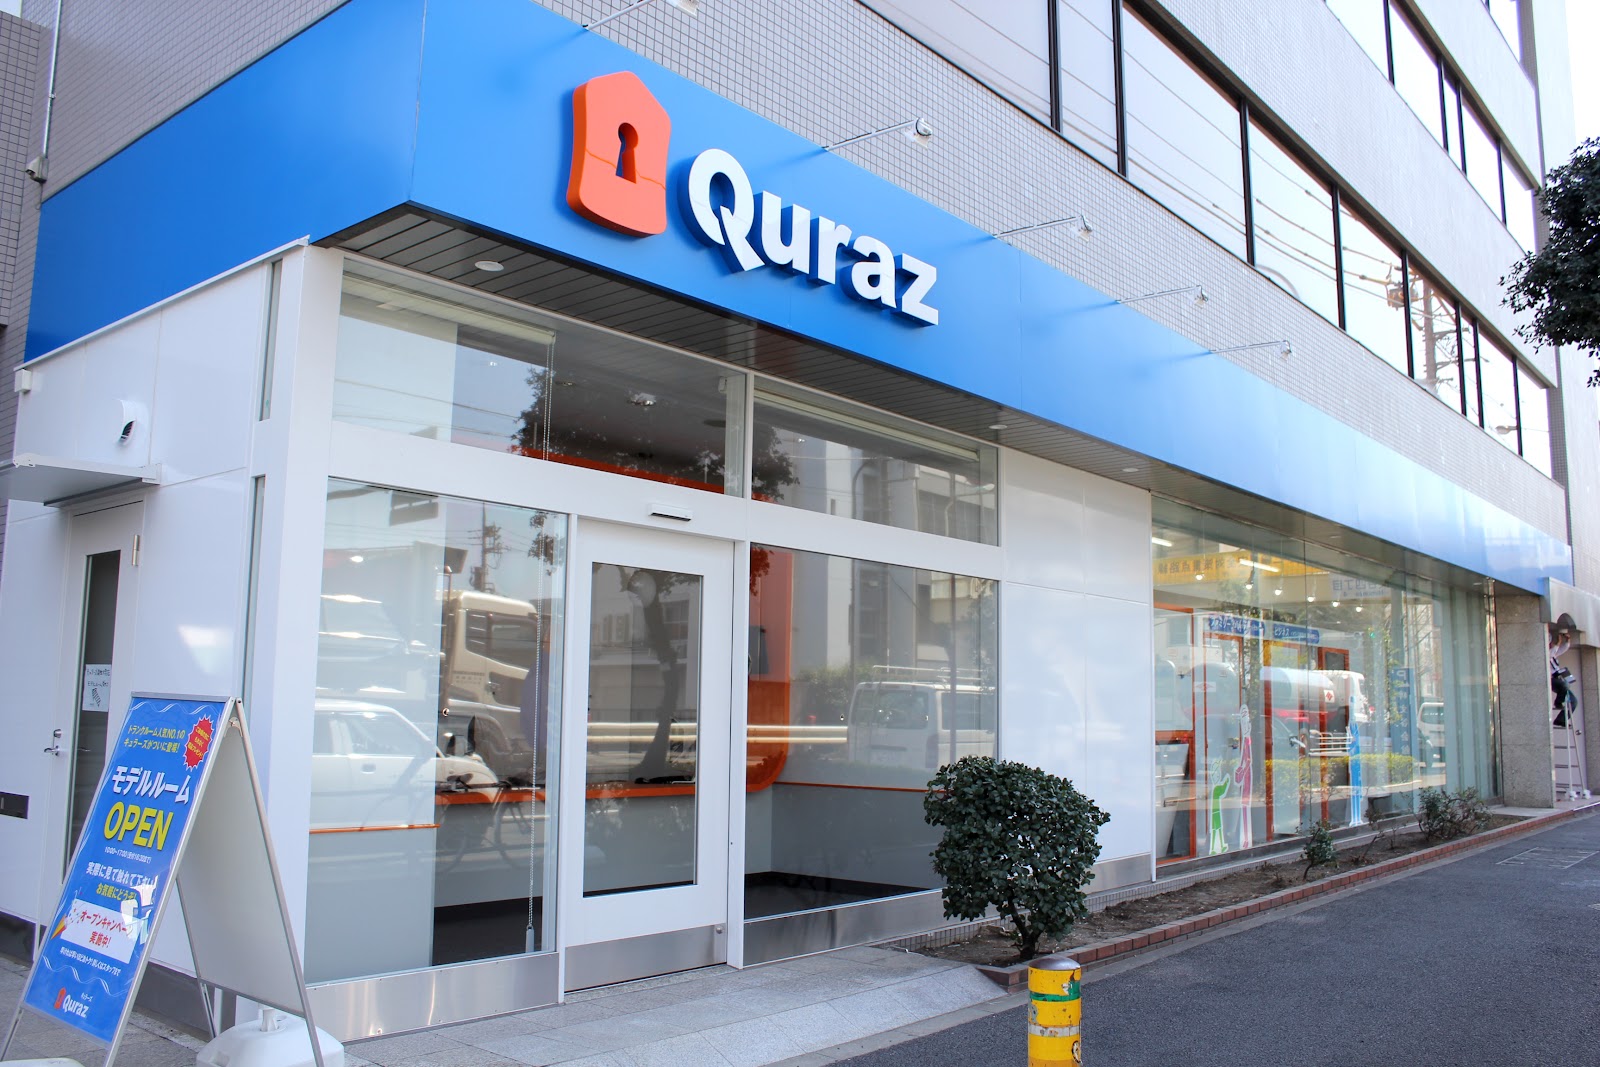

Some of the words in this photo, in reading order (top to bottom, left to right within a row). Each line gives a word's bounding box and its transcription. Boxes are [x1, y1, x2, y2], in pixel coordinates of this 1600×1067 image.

[688, 148, 939, 326] Quraz
[112, 765, 191, 805] モデルルーム
[104, 801, 174, 851] OPEN
[62, 994, 90, 1018] Quraz
